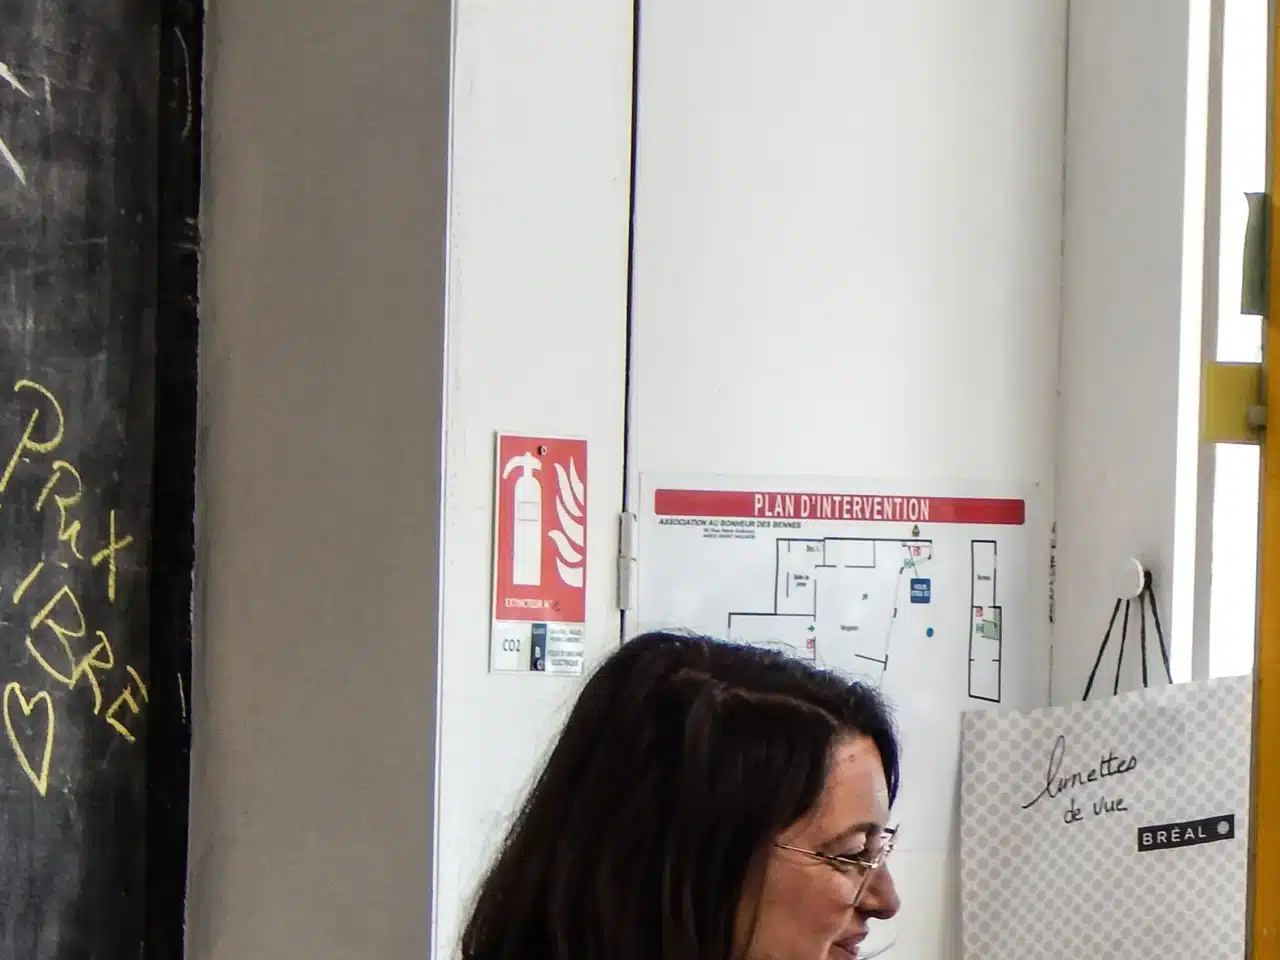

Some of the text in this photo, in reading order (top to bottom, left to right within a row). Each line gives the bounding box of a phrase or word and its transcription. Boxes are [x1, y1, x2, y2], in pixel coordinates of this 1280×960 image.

[754, 493, 930, 521] PLAN D'INTERVENTION
[658, 518, 706, 526] ASSOCIATION
[708, 519, 719, 527] AU
[720, 519, 756, 528] BONHEUR
[757, 520, 771, 528] DES
[502, 639, 521, 652] CO2
[1022, 734, 1137, 809] lunettes
[1063, 797, 1128, 824] de vue
